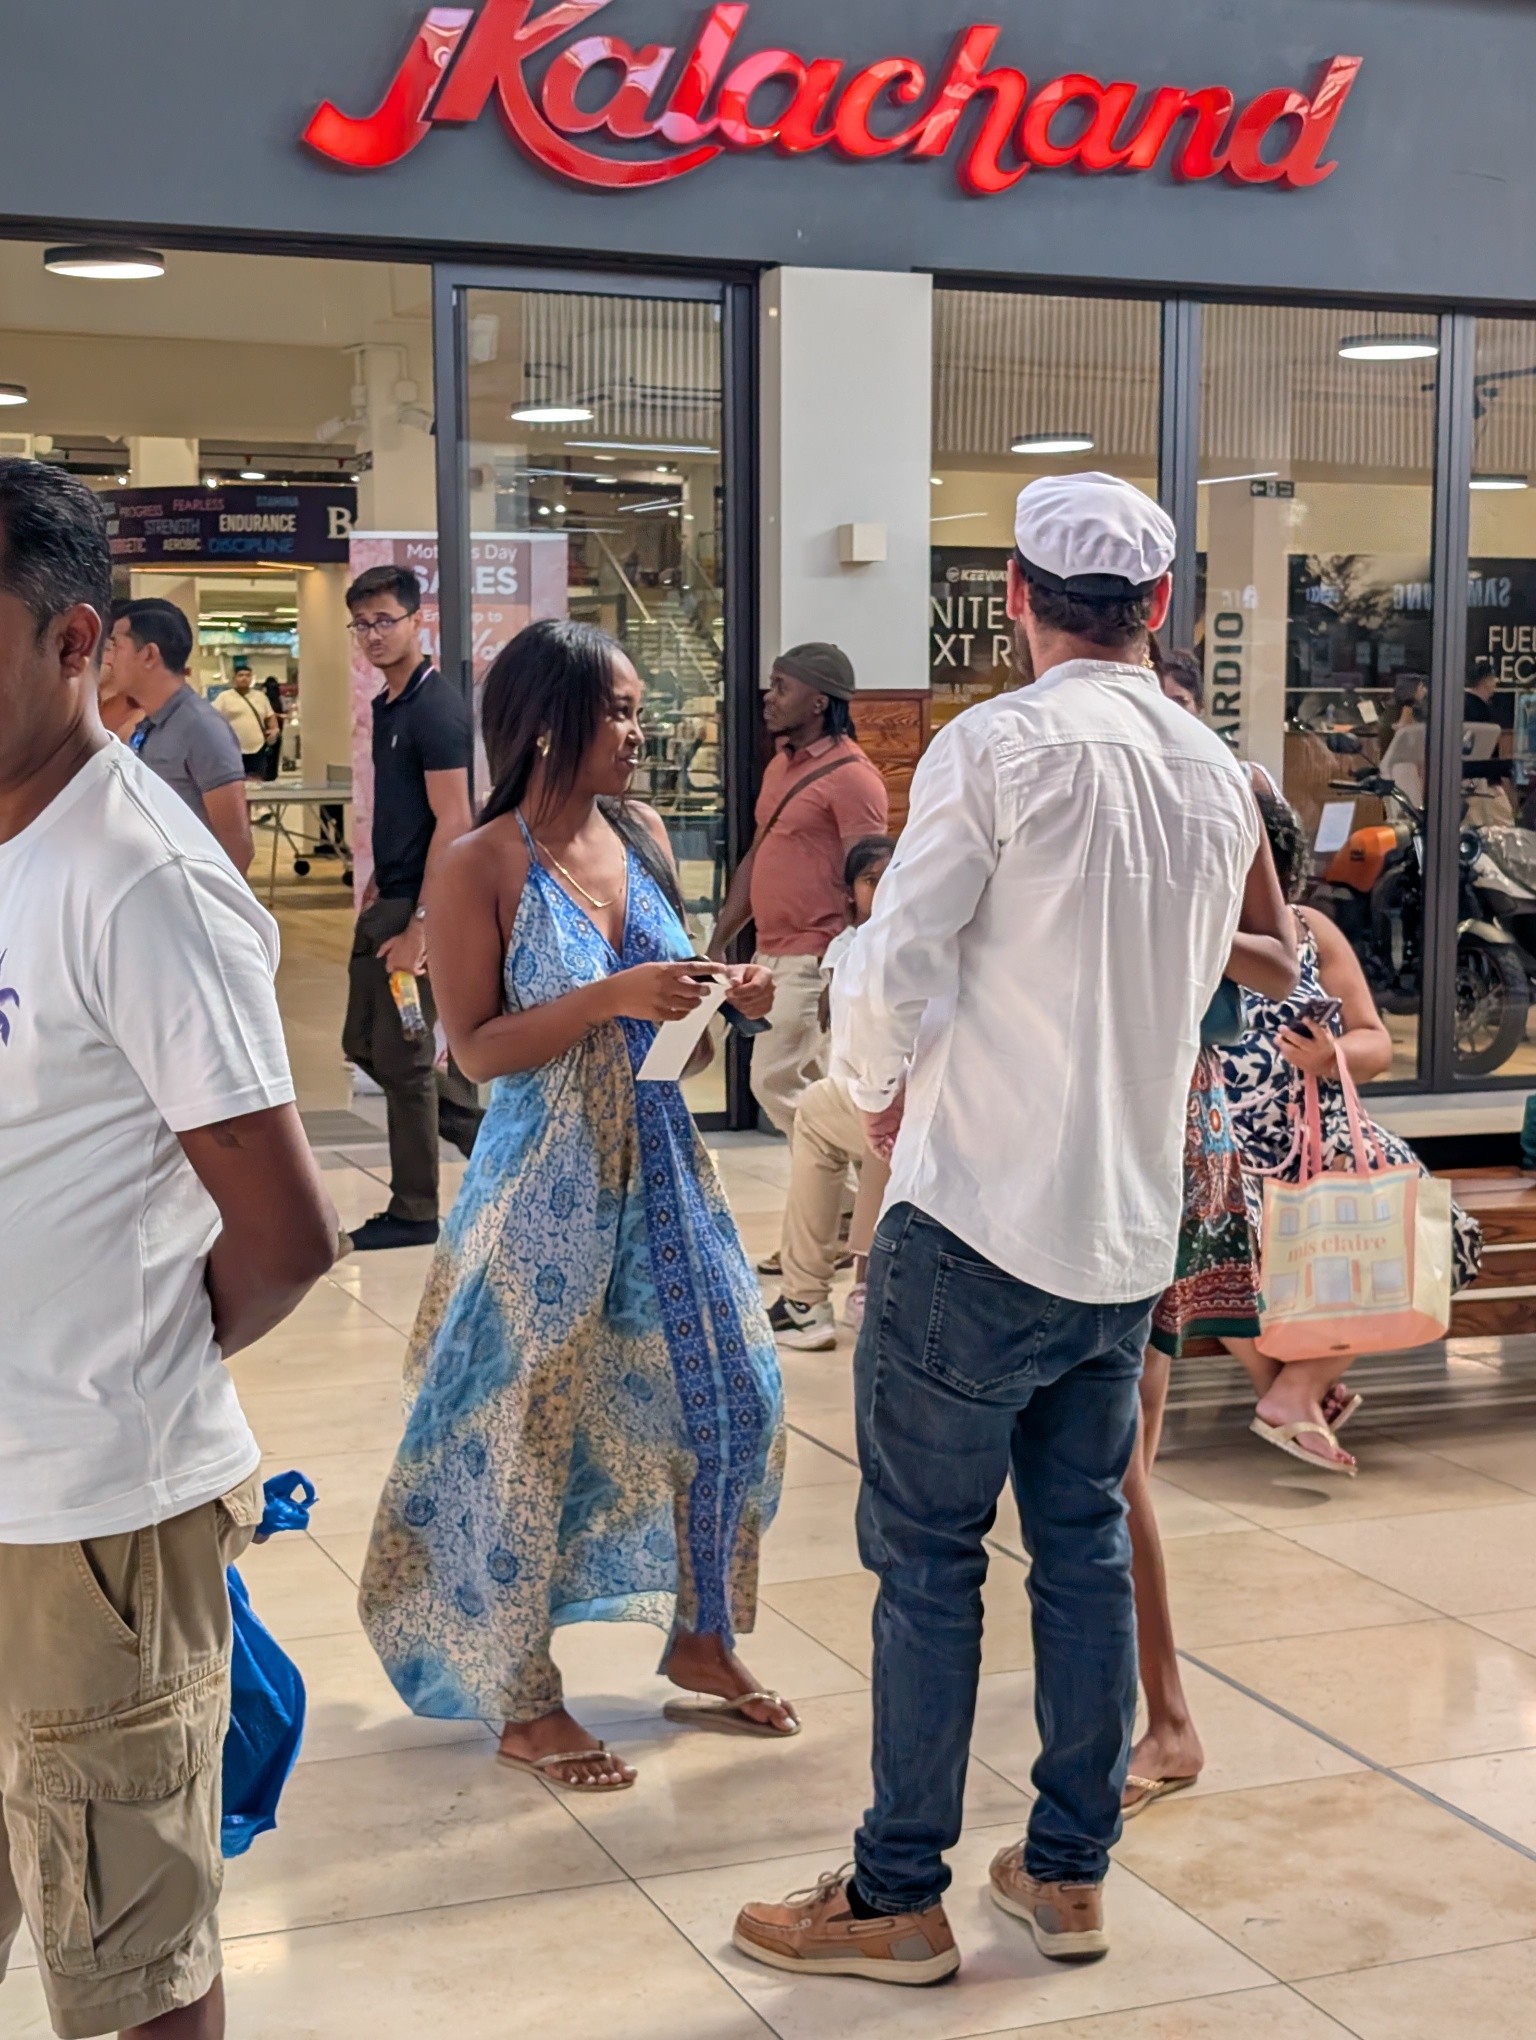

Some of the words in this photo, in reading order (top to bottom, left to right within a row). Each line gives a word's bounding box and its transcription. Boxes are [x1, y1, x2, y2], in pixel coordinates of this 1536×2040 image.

[144, 518, 200, 535] STRENGTH
[219, 513, 297, 532] ENDURANCE
[208, 538, 295, 554] DISCIPLINE
[407, 544, 480, 560] Mots
[485, 545, 518, 562] Day
[415, 565, 518, 595] SES
[960, 569, 1007, 582] KEEWA
[488, 611, 503, 622] to
[930, 596, 1004, 629] NITE
[933, 633, 975, 667] XT
[1212, 612, 1243, 749] ARDIO
[1321, 1233, 1387, 1253] claire
